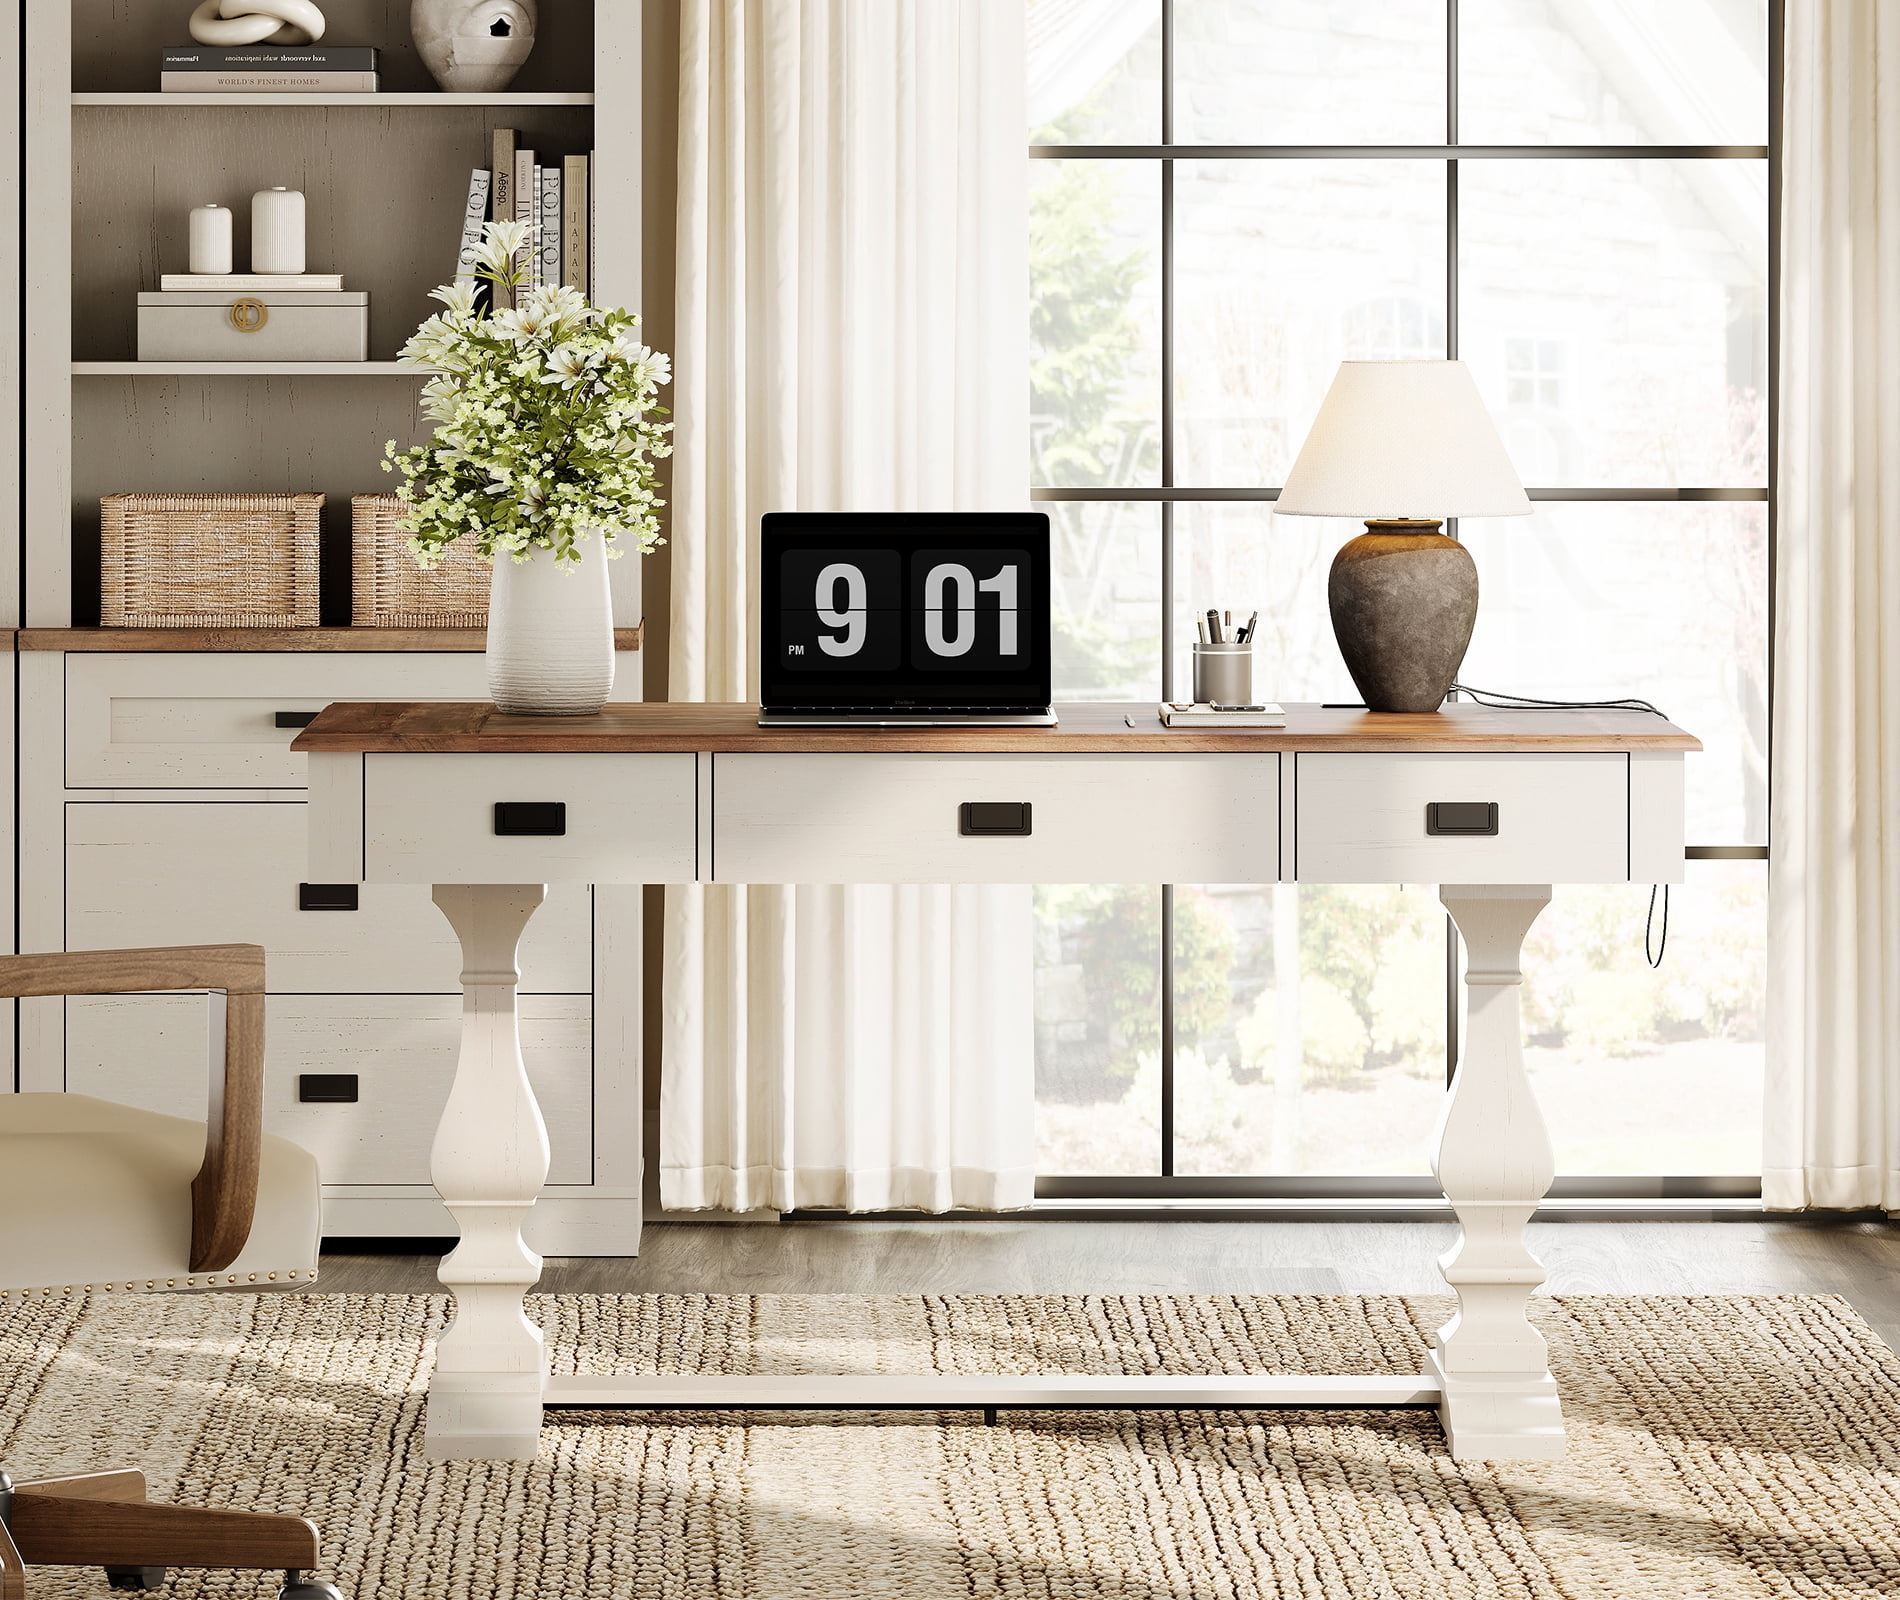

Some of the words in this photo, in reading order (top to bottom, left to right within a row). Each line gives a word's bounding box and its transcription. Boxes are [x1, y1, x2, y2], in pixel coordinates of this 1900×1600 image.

[217, 78, 255, 86] WORLD'S
[257, 78, 287, 86] FINEST
[290, 78, 320, 86] HOMES
[543, 177, 559, 266] POLPO
[571, 211, 579, 282] JAPAN
[815, 563, 867, 658] 9
[925, 563, 1018, 658] 01
[788, 645, 805, 656] PM
